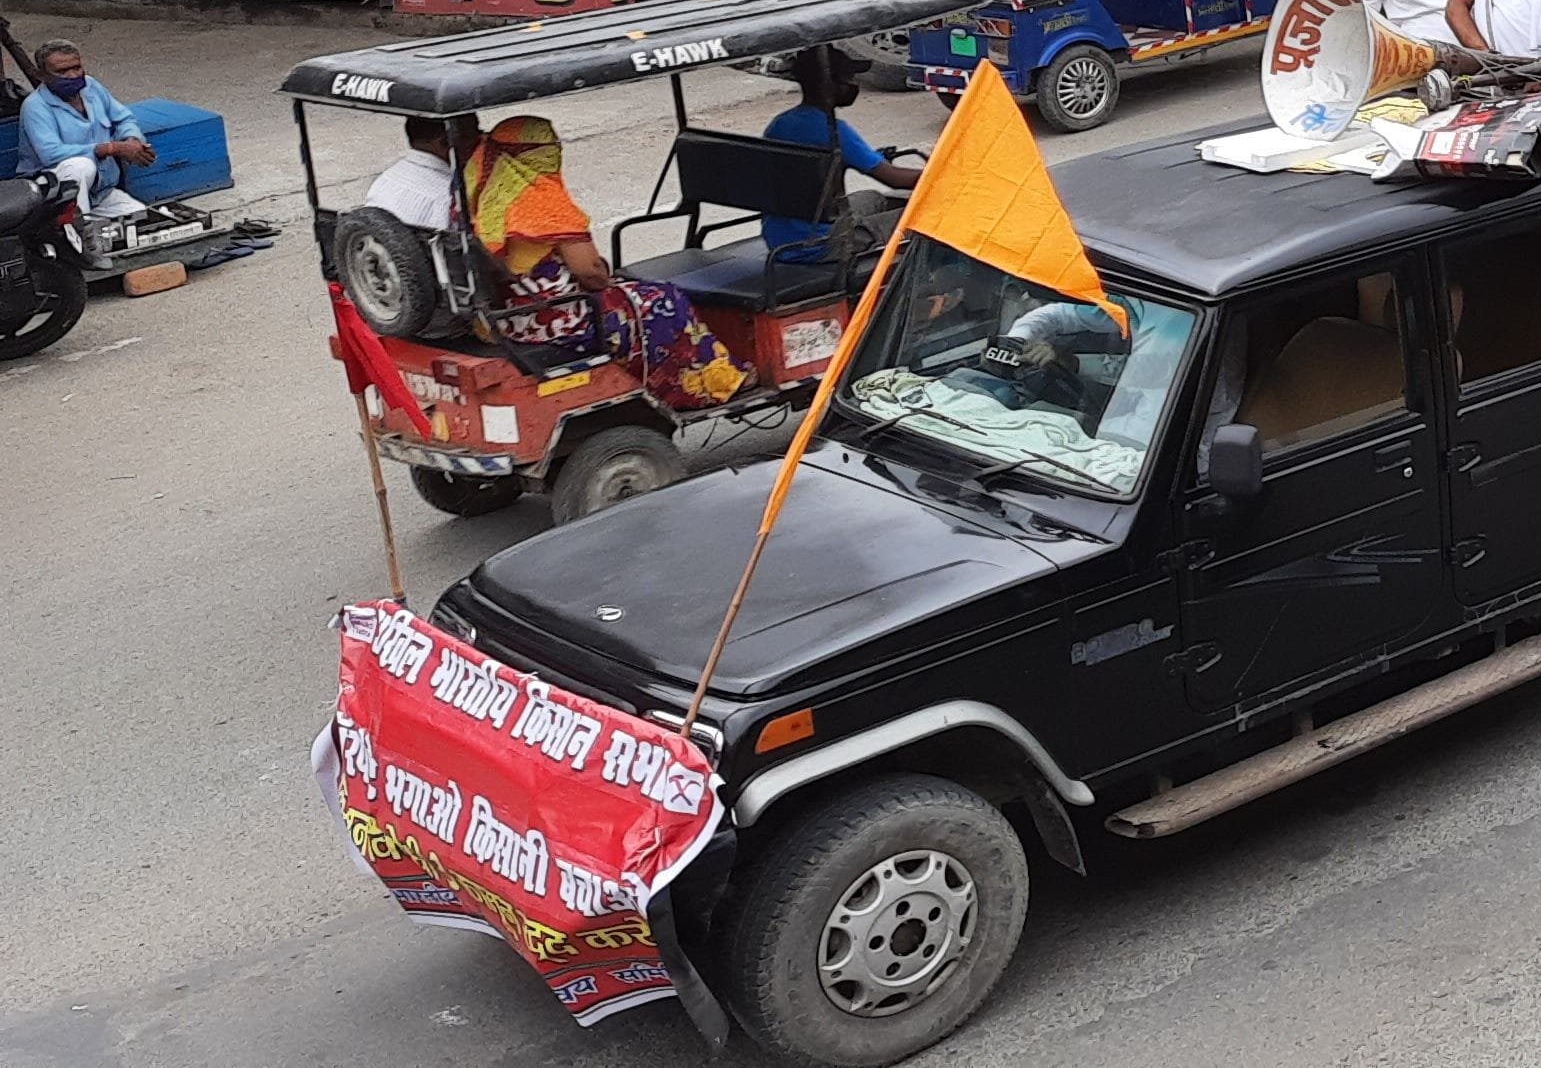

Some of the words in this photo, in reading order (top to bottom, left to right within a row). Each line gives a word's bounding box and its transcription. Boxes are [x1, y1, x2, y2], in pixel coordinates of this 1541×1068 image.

[330, 71, 396, 104] E-HAWK
[630, 37, 731, 73] E-HAWK
[431, 646, 521, 730] भारतीय
[511, 678, 601, 771] किसान
[602, 729, 673, 800] सभा
[384, 763, 464, 846] भगाओ
[463, 795, 552, 897] किसानी
[556, 858, 651, 919] बचाओ
